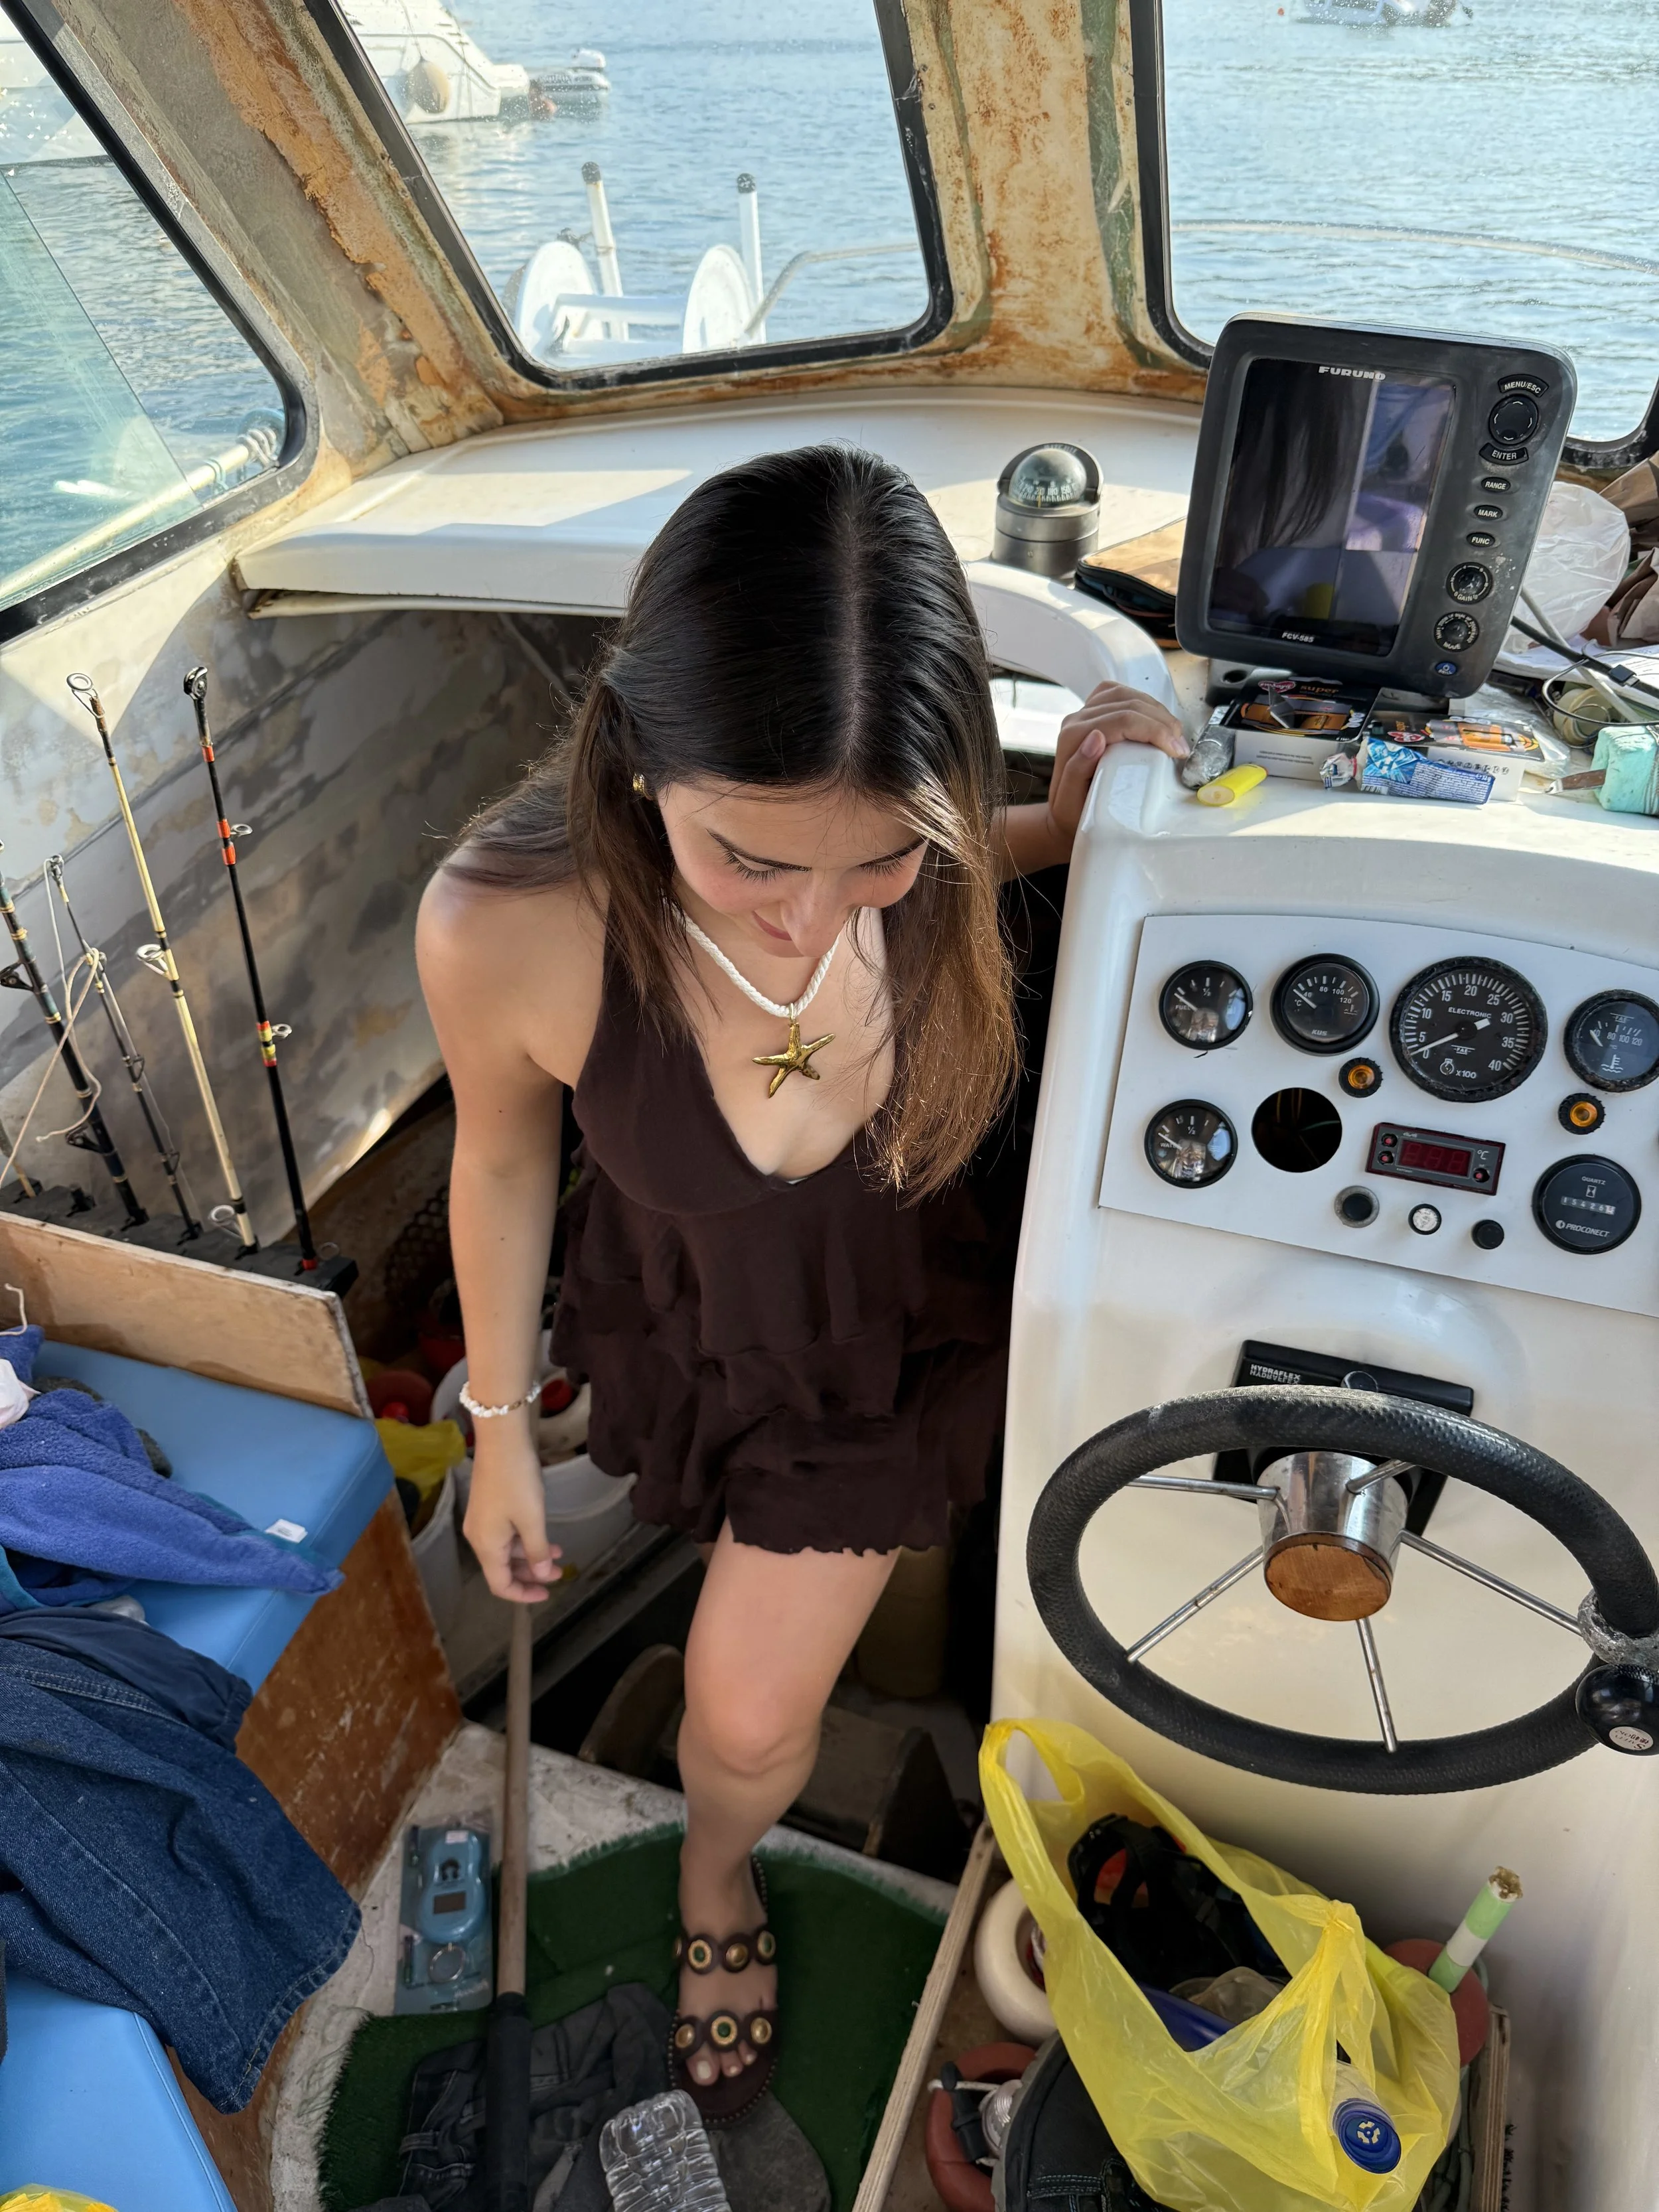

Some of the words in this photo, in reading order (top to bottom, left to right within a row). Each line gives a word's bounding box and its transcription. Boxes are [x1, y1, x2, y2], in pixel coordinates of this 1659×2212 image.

[1318, 366, 1386, 380] FURUNO
[1504, 381, 1542, 394] MENU/ESC
[1491, 449, 1517, 460] ENTER
[1484, 480, 1507, 490] RANGE
[1478, 509, 1498, 518] MARK
[1471, 536, 1490, 545] FUNC
[1441, 990, 1452, 1002] 15
[1464, 985, 1477, 997] 20
[1486, 994, 1500, 1006] 25
[1421, 1007, 1431, 1019] 10
[1448, 1006, 1492, 1019] ELECTRONIC
[1500, 1012, 1513, 1024] 30
[1418, 1031, 1426, 1043] 5
[1502, 1037, 1515, 1049] 35
[1607, 1031, 1616, 1040] 80
[1619, 1035, 1630, 1043] 100
[1631, 1037, 1642, 1046] 120
[1422, 1049, 1429, 1060] 0
[1488, 1059, 1502, 1071] 40
[1477, 1149, 1489, 1160] °C
[1581, 1176, 1607, 1185] QUARTZ
[1565, 1223, 1611, 1237] PROCONECT
[1250, 1364, 1301, 1380] HYDRAFLEX
